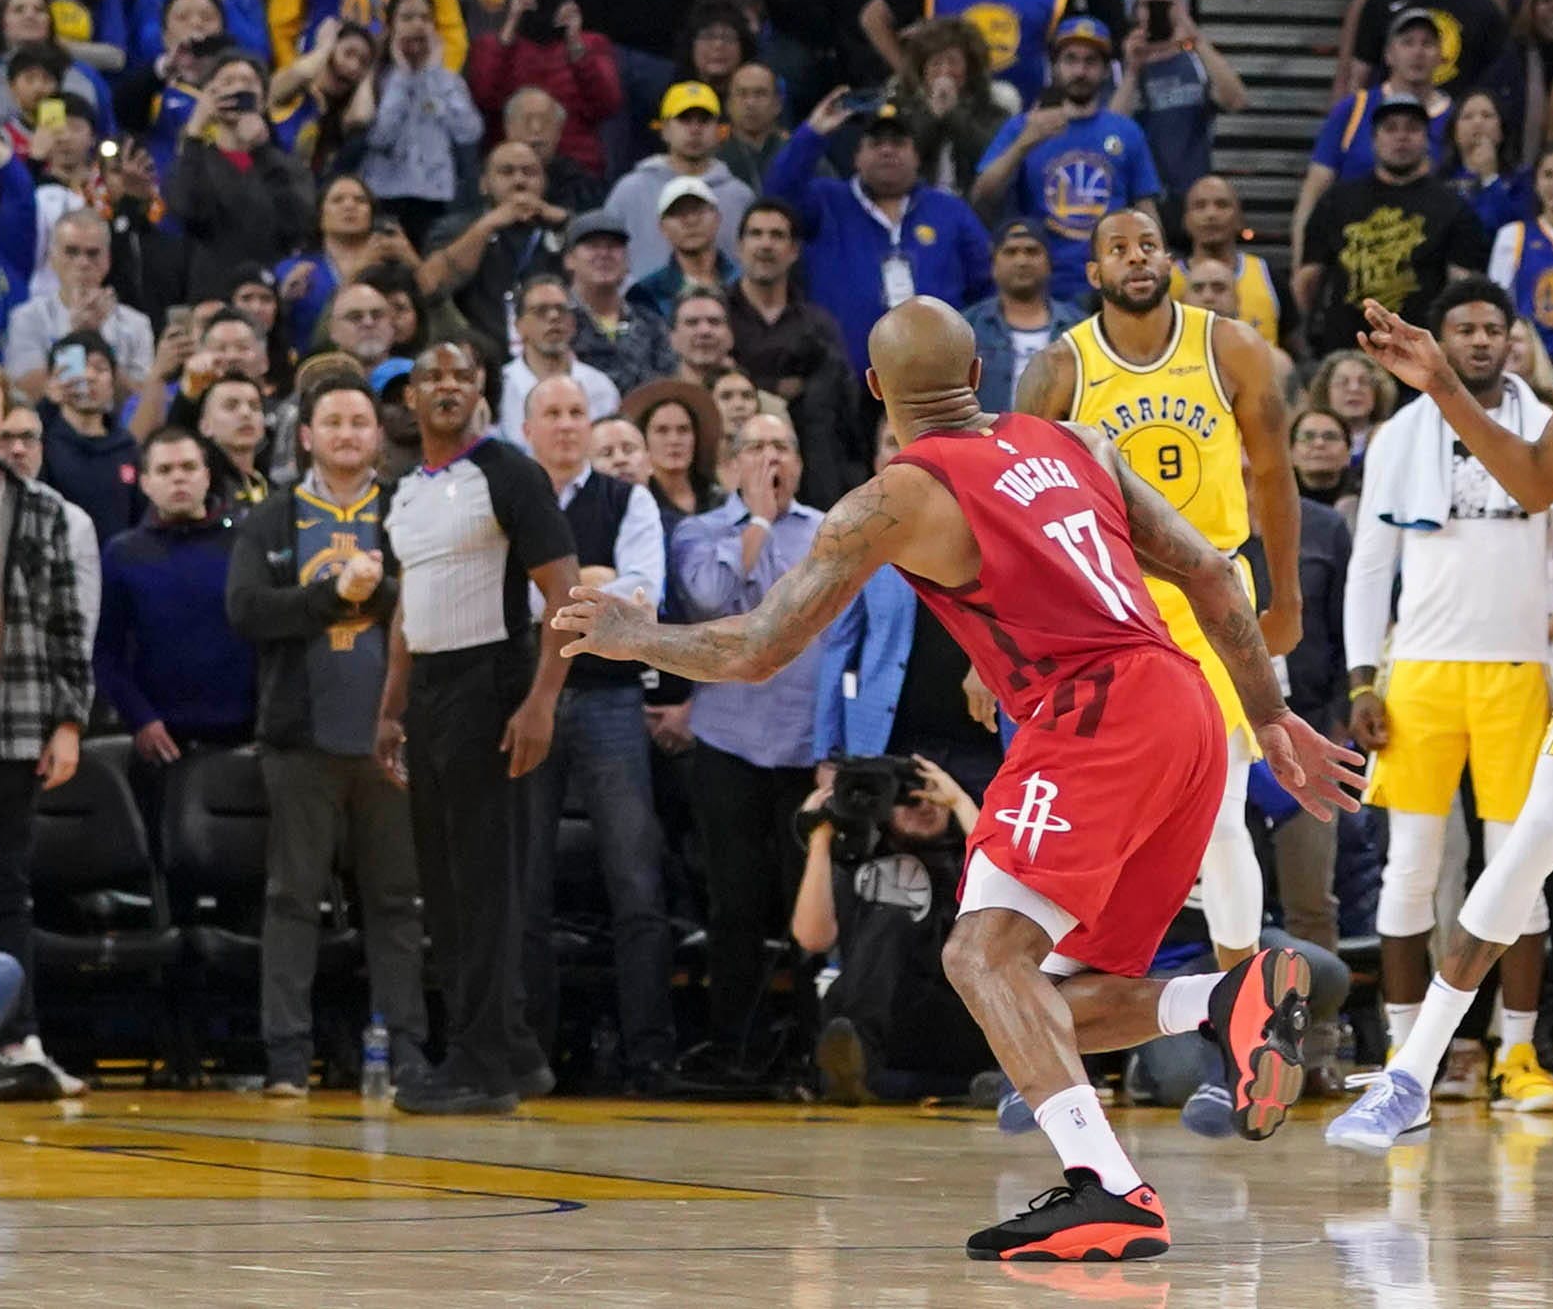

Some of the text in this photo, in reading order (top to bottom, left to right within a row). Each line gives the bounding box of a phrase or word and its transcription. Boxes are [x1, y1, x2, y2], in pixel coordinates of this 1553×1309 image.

[1100, 396, 1217, 440] ARRIORS
[993, 456, 1080, 507] TUCKER
[1158, 445, 1182, 480] 9
[1042, 509, 1140, 622] 17
